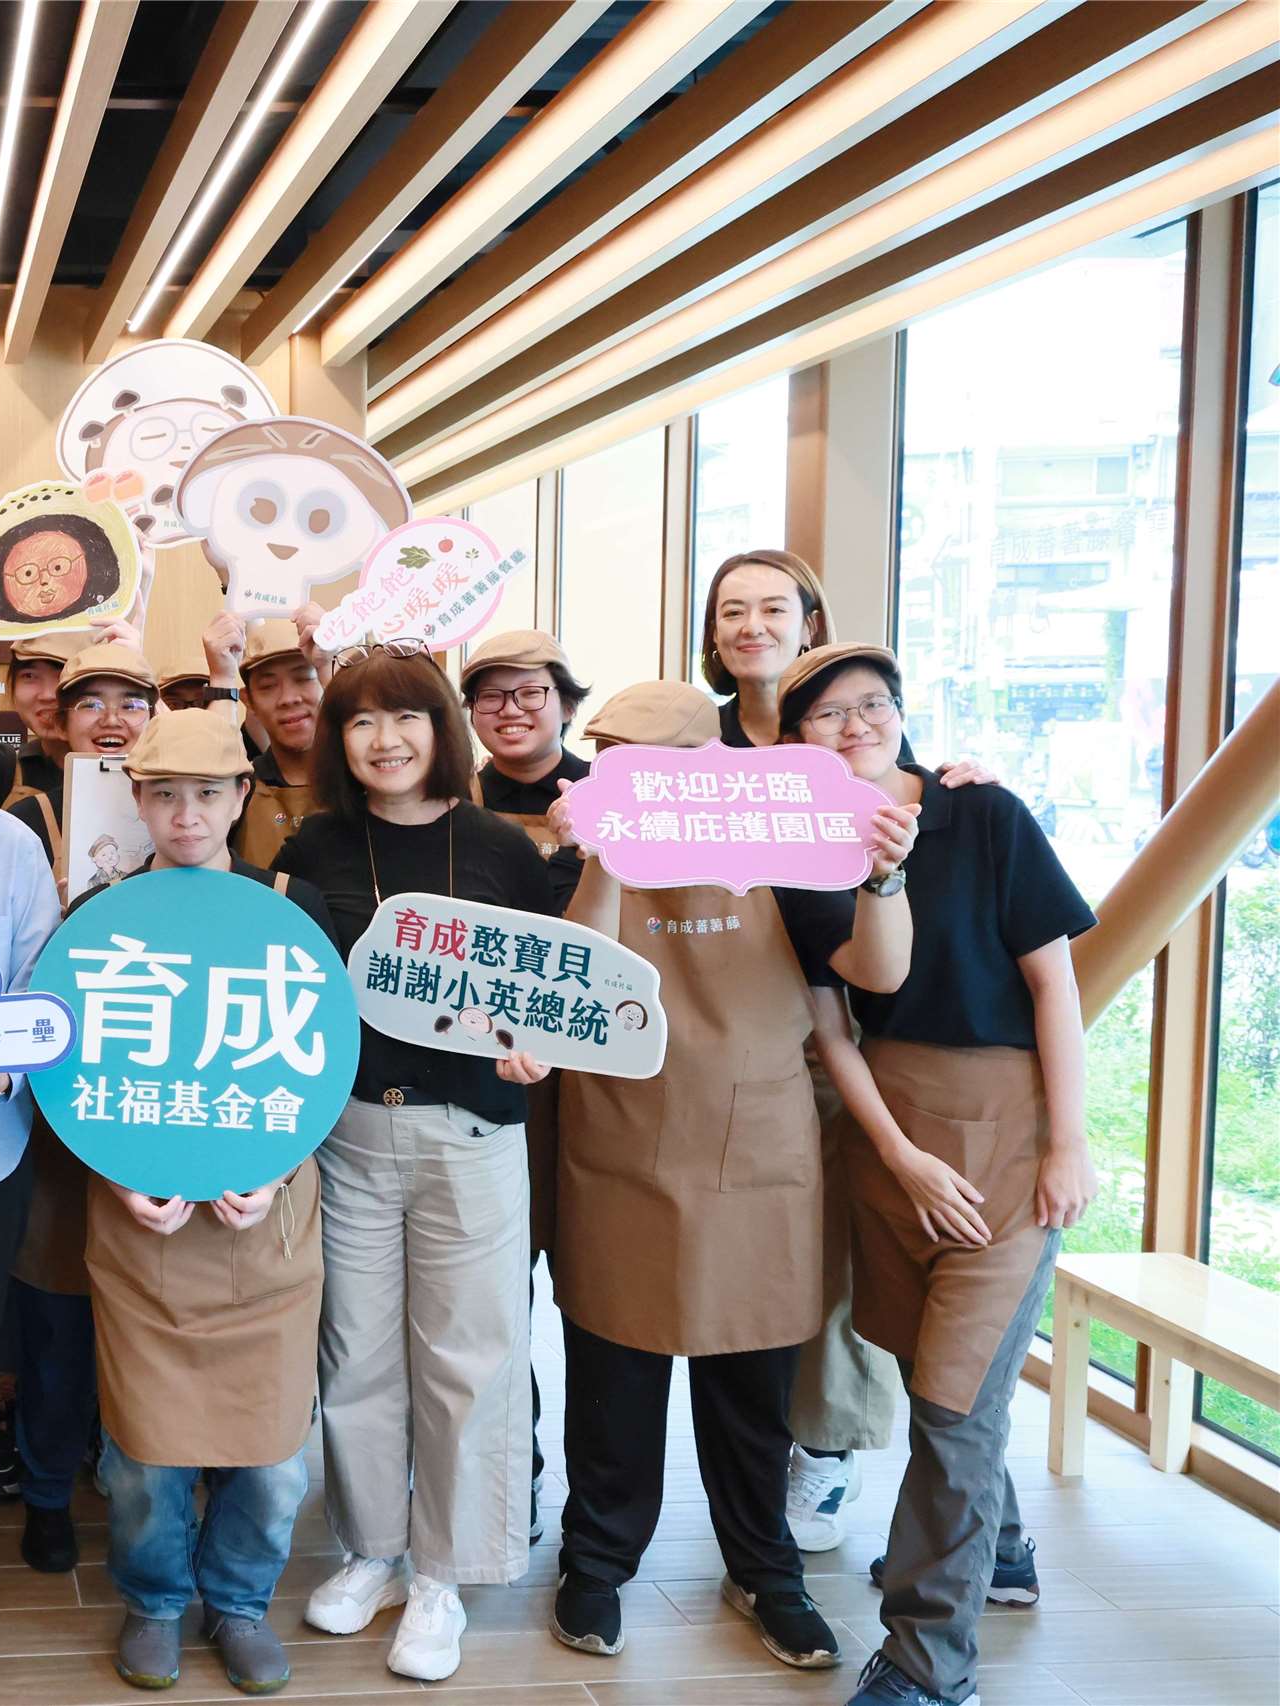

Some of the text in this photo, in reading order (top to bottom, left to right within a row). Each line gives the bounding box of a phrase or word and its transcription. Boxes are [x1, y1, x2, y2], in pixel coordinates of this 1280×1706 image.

[322, 566, 416, 642] 吃飽飽
[377, 561, 470, 641] 心暖暖
[629, 770, 814, 804] 歡迎光臨
[596, 810, 862, 844] 永續庇護園區
[393, 907, 592, 990] 育成憨寶貝
[67, 933, 327, 1077] 育成
[365, 949, 611, 1046] 謝謝小英總統
[70, 1073, 305, 1134] 社福基金會
